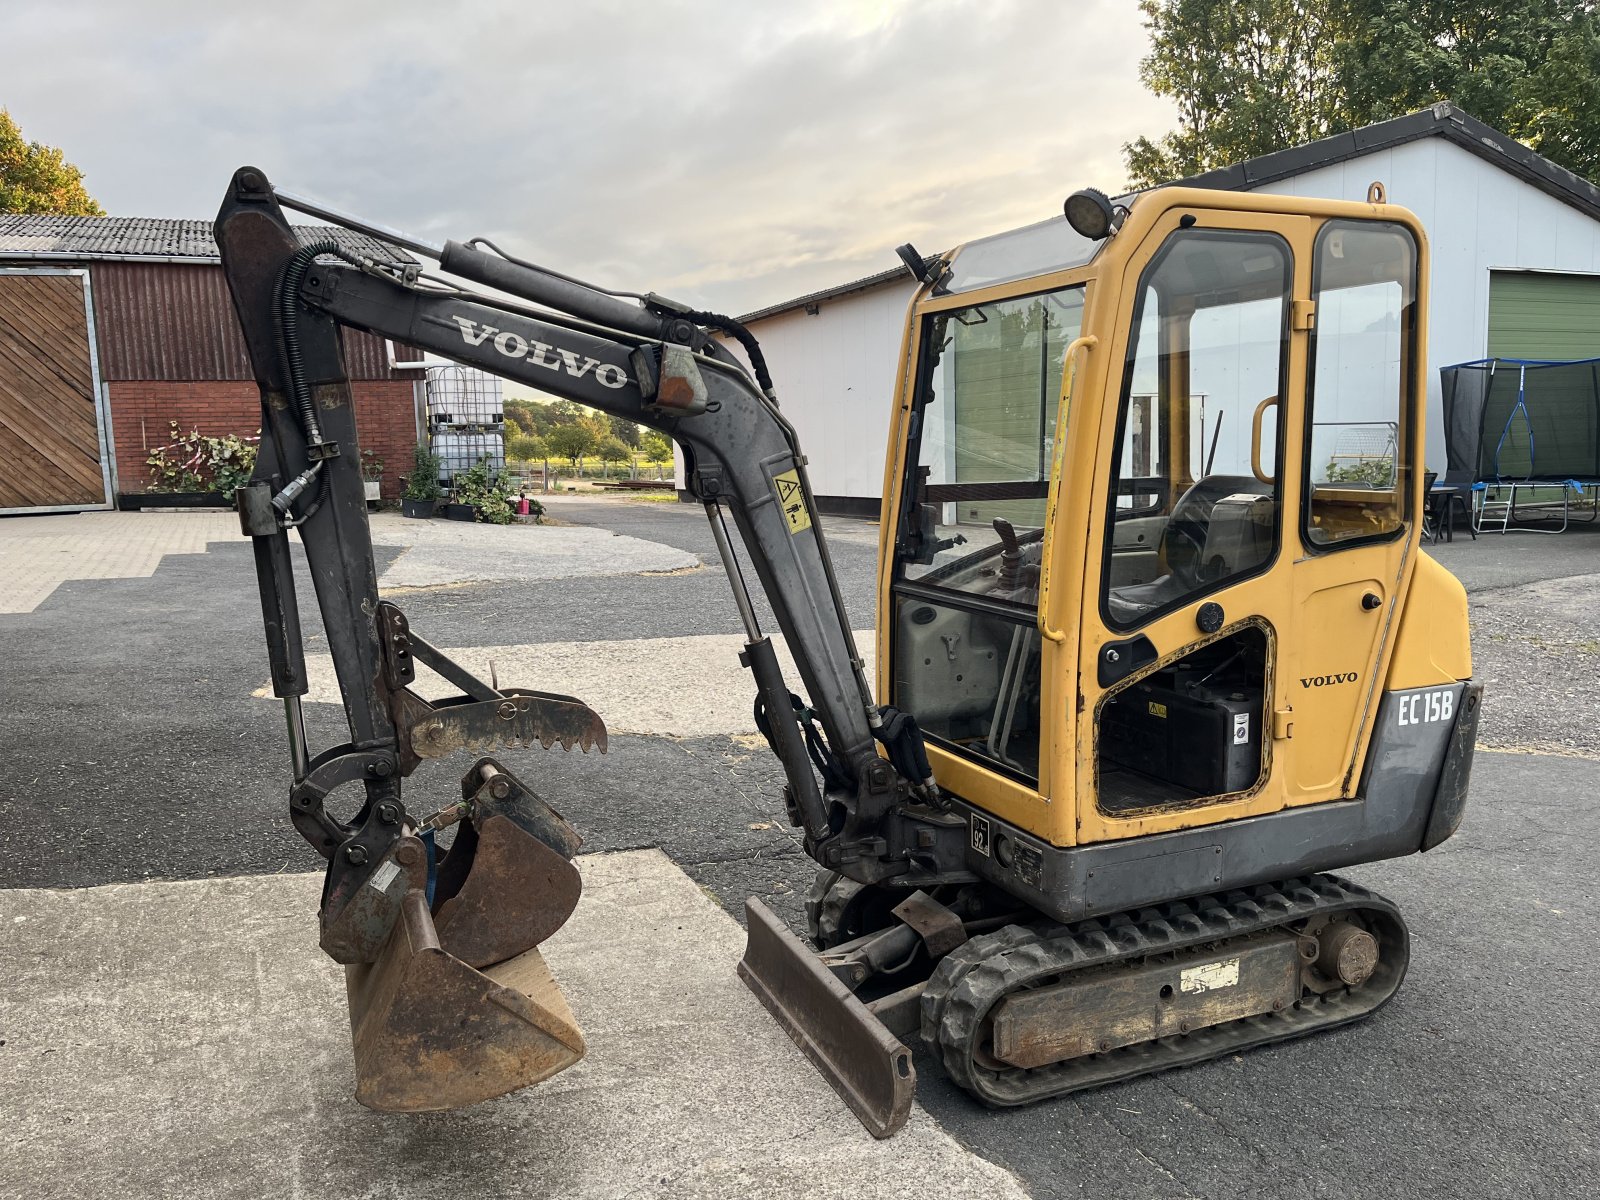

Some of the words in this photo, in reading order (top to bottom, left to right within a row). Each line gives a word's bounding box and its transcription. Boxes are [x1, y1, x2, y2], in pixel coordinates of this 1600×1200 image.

[452, 315, 628, 389] VOLVO
[1300, 672, 1358, 688] VOLVO
[974, 830, 983, 849] 92
